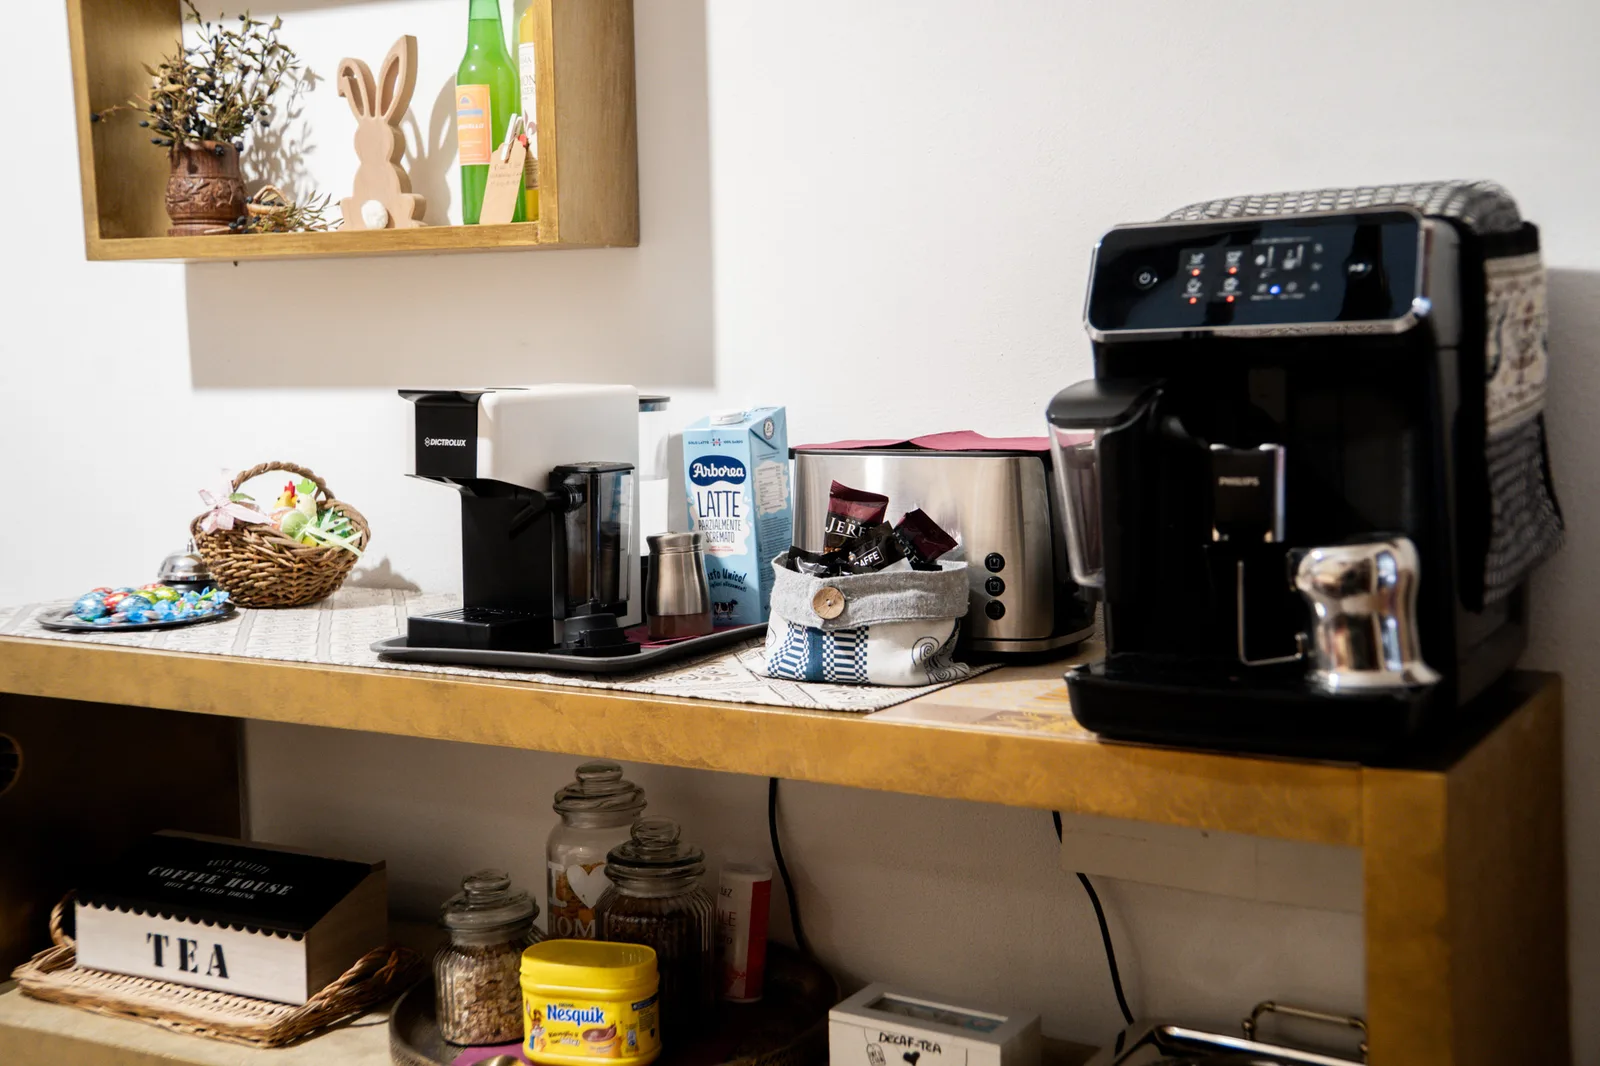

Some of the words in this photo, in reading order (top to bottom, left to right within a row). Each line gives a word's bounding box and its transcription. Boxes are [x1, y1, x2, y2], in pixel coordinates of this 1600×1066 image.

[430, 438, 466, 447] DICTROLUX
[692, 462, 745, 478] Arborea
[697, 490, 741, 518] LATTE
[698, 519, 742, 531] PARZIALMENTE
[705, 531, 735, 544] SCREMATO
[722, 568, 748, 585] Unico!
[147, 865, 222, 886] COFFEE
[224, 877, 294, 896] HOUSE
[163, 881, 186, 889] HOT
[199, 886, 226, 895] COLD
[146, 932, 230, 979] TEA
[546, 1003, 606, 1026] Nesquik
